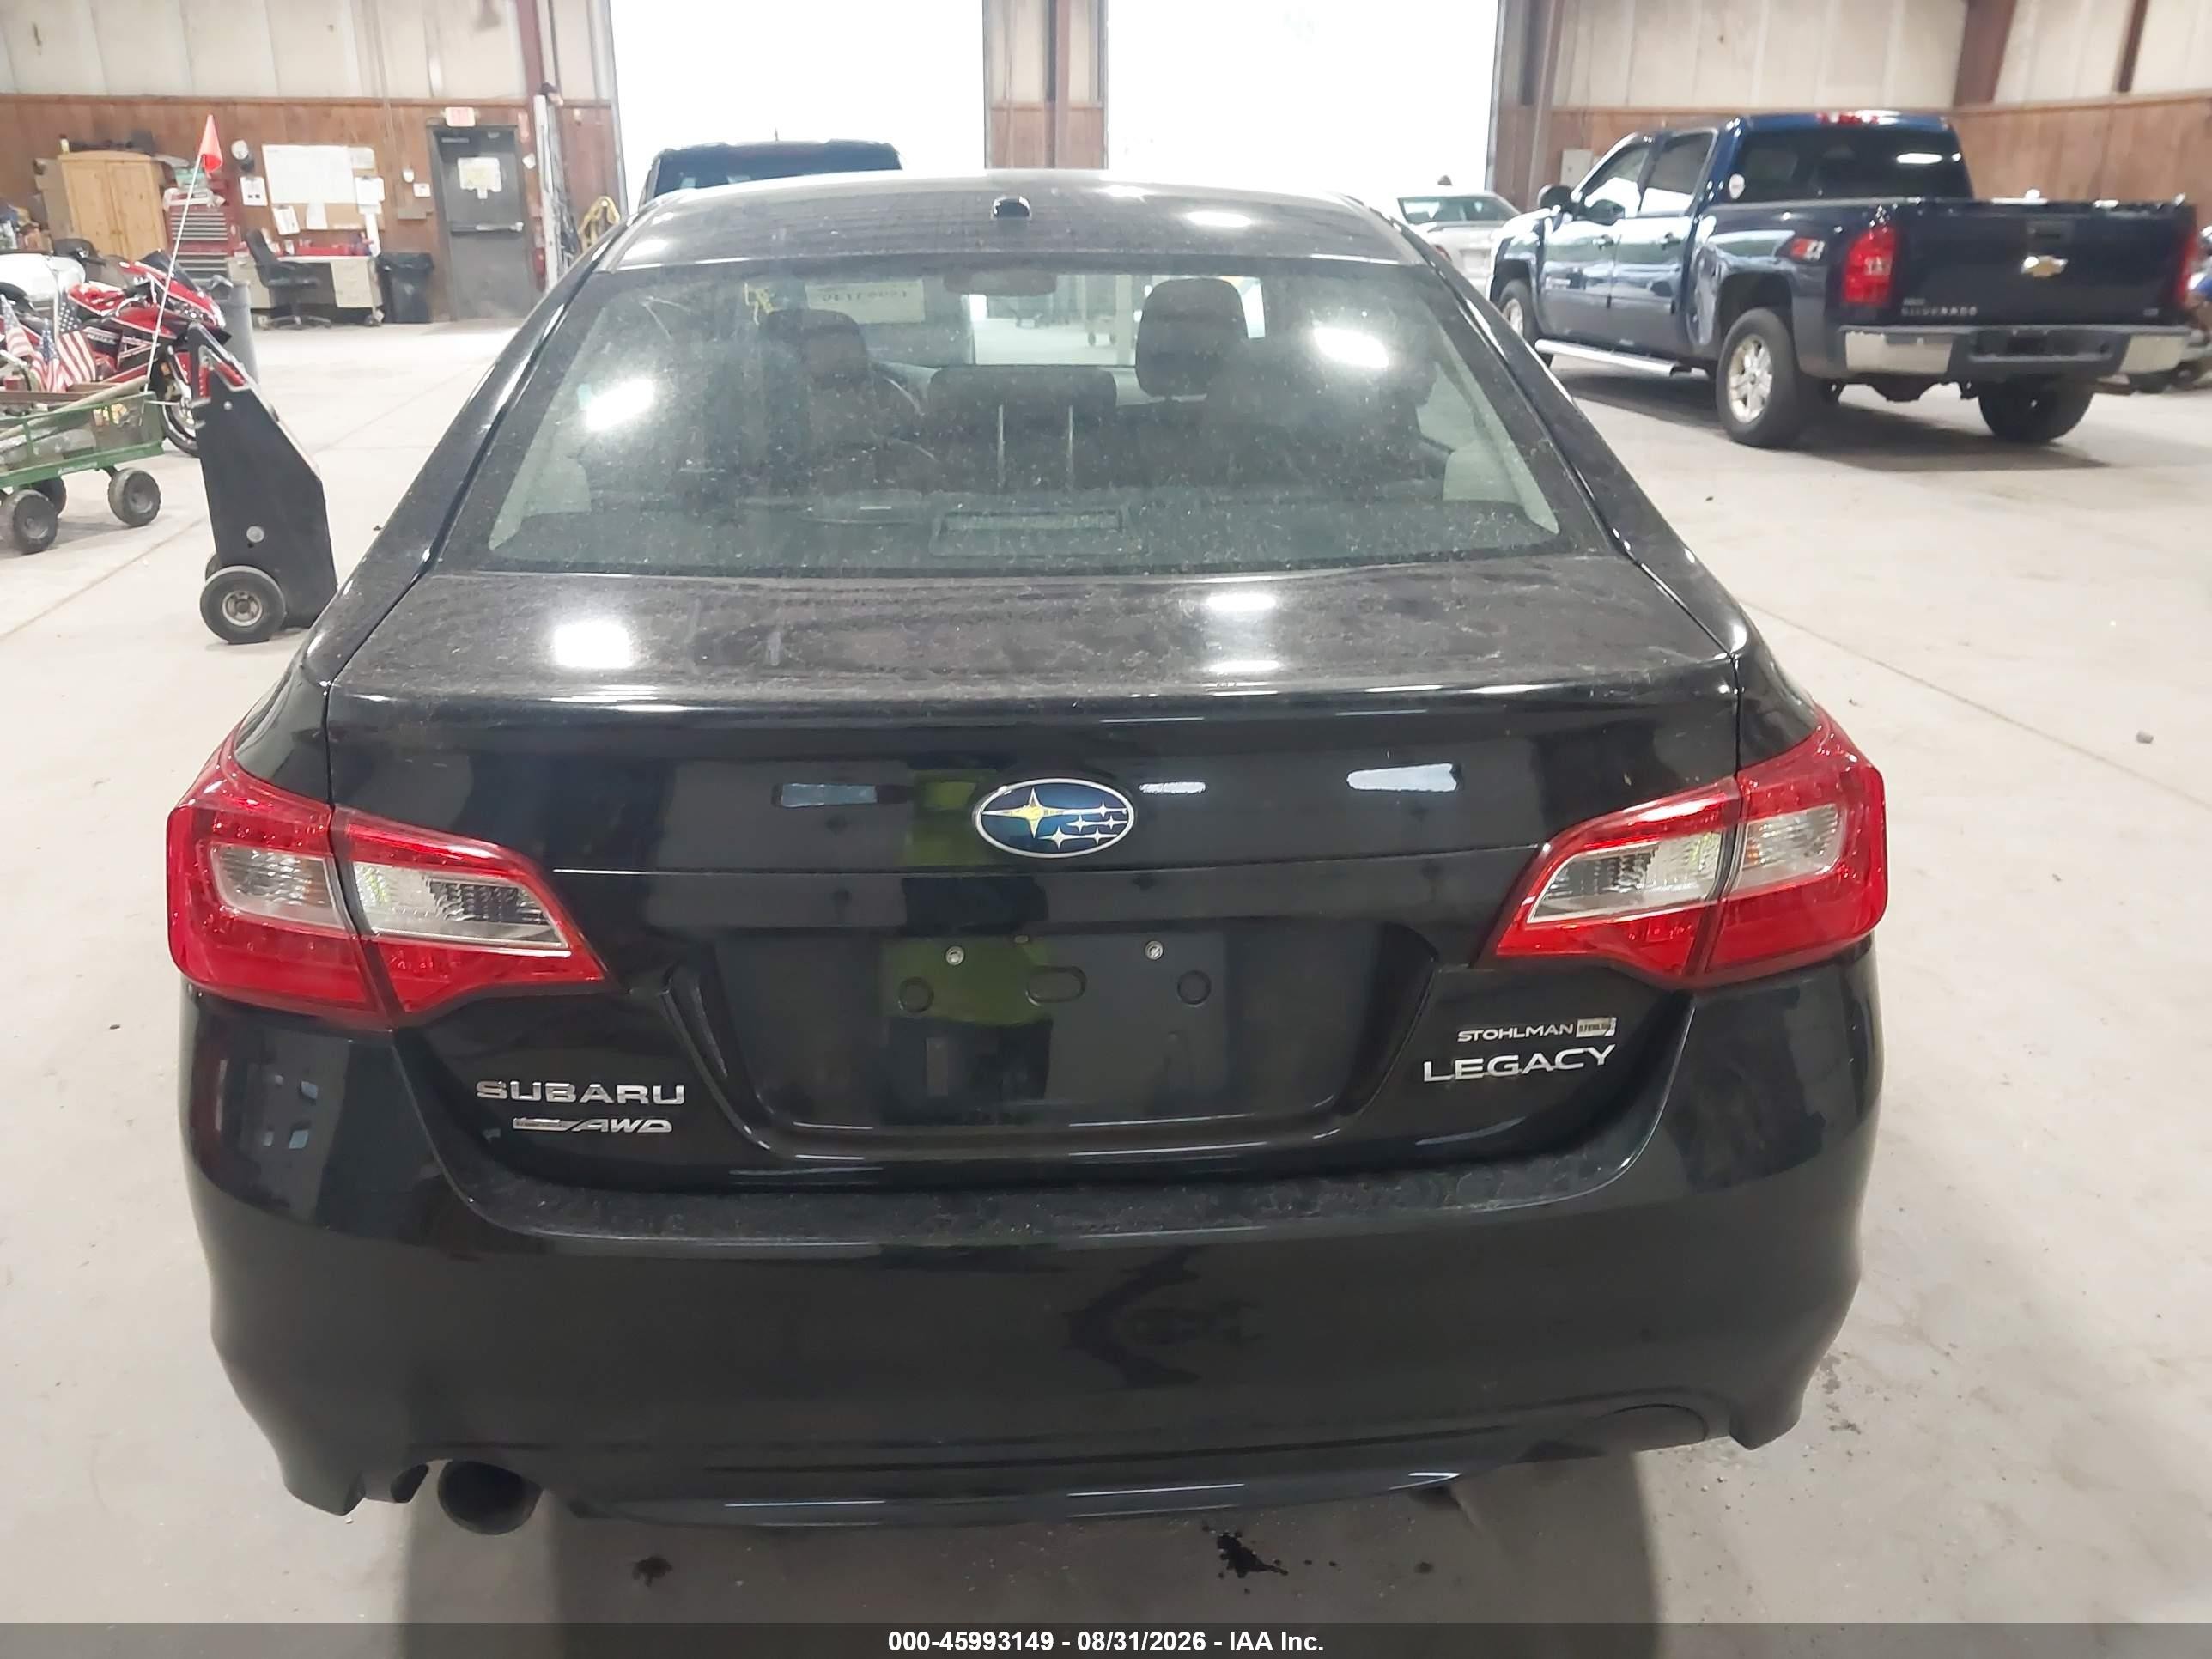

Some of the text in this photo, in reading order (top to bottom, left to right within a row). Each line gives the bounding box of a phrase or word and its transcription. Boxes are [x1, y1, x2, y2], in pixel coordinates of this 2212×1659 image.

[1456, 1023, 1575, 1042] STOHLMAN
[1423, 1044, 1616, 1083] LEGACY
[476, 1080, 685, 1105] SUBARU
[571, 1118, 673, 1133] AWD
